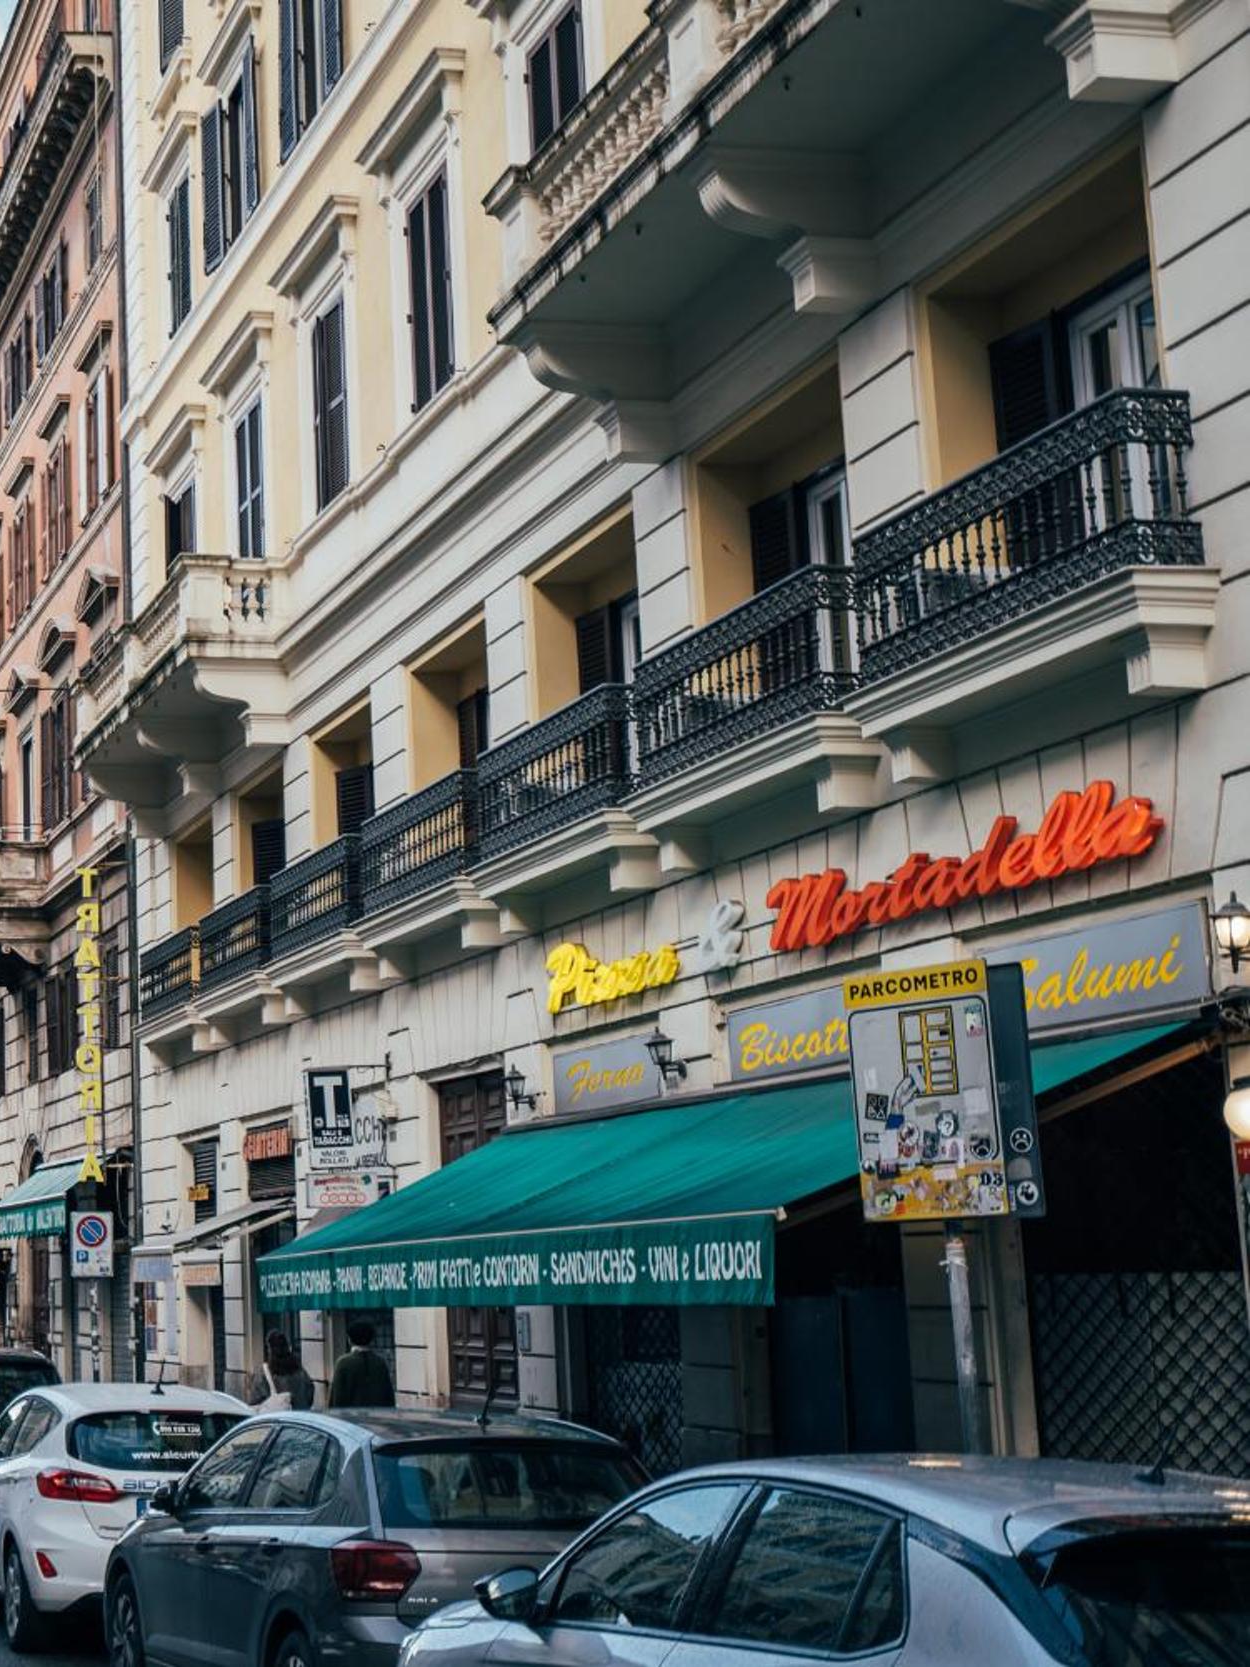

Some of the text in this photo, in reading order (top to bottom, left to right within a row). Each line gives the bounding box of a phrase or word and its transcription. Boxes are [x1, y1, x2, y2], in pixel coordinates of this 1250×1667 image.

[546, 780, 1165, 1014] Pizza & Mortadella
[850, 967, 978, 1001] PARCOMETRO
[737, 1017, 849, 1072] Biscott
[312, 1075, 343, 1129] T
[566, 1059, 645, 1103] Forno
[550, 1248, 637, 1285] SANDWICHES
[648, 1246, 679, 1282] VINI
[682, 1252, 689, 1280] e
[694, 1240, 763, 1281] LIQUORI
